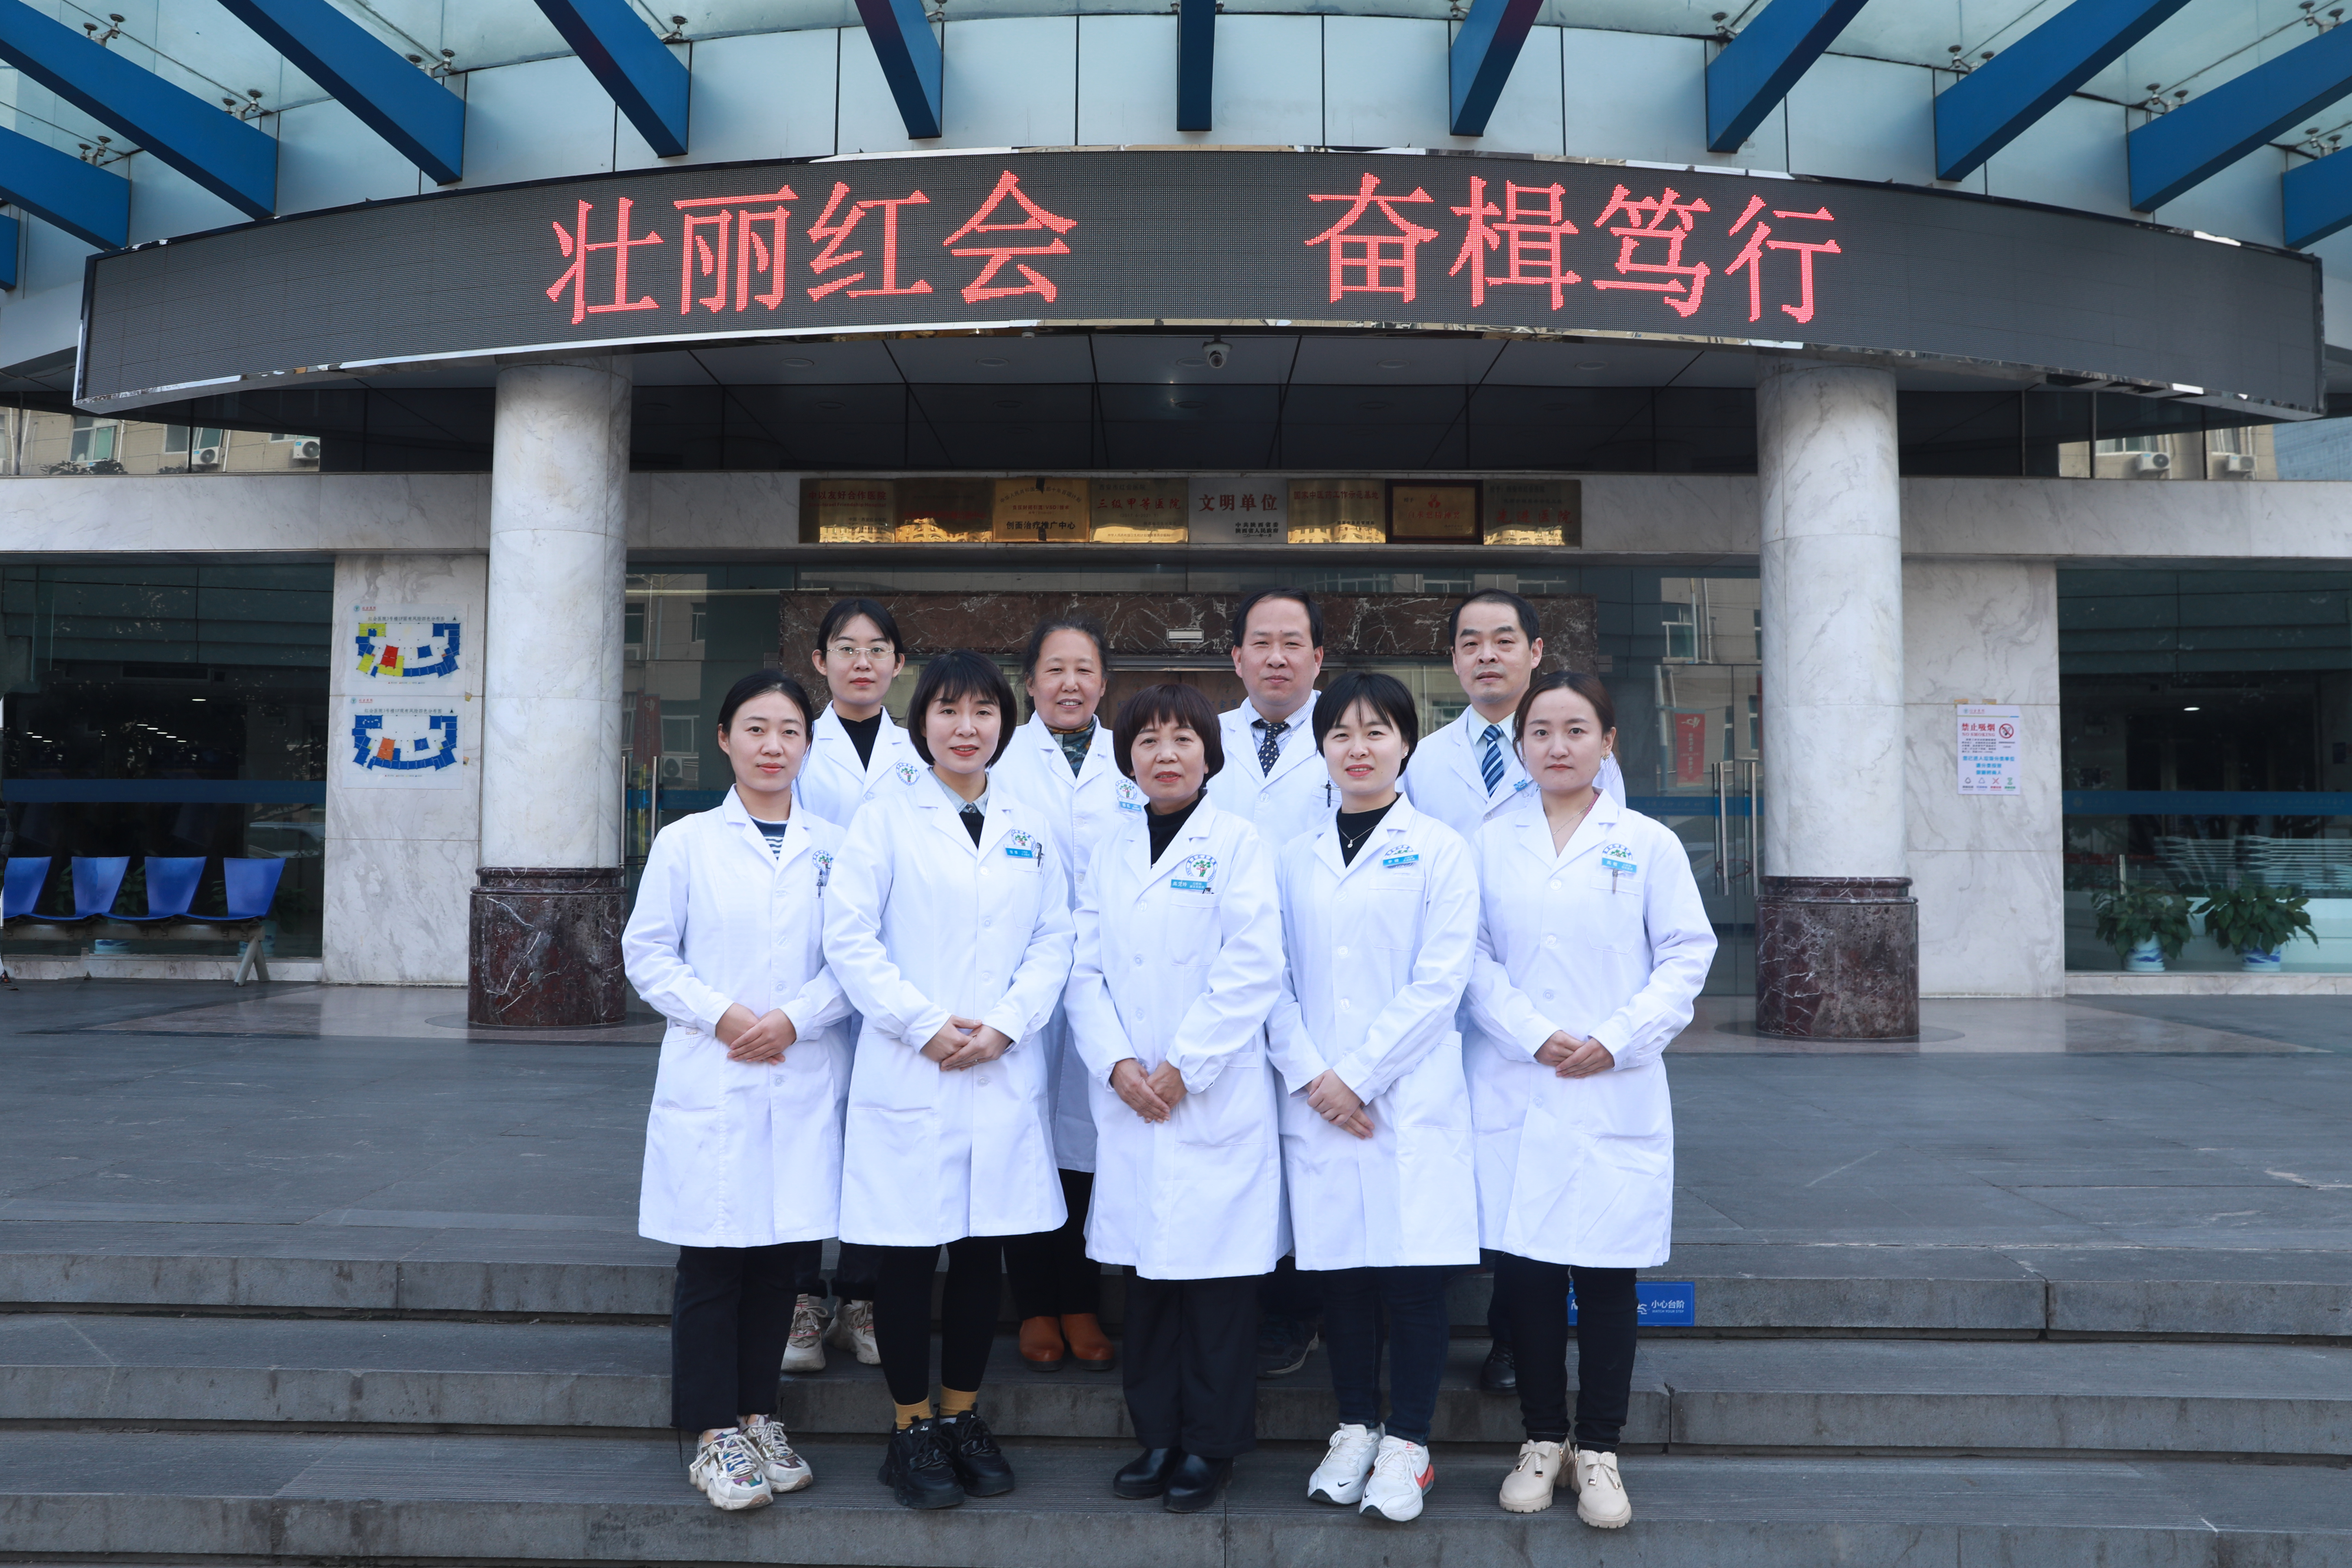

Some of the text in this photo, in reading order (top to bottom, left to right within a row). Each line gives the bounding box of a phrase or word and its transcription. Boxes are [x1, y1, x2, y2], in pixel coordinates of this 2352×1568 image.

[546, 170, 1841, 324] 壮丽红会 奋楫笃行
[809, 491, 886, 500] 中以友好合作医院
[1000, 486, 1082, 503] 中华人民共和国部十年百项计划
[1294, 491, 1379, 500] 国家中医药工作示范基地
[1097, 497, 1181, 510] 三级甲等医院
[1199, 493, 1278, 511] 文明单位
[1407, 510, 1460, 519] 白求恩精神奖
[1496, 508, 1572, 524] 先进医院
[1006, 521, 1076, 530] 创面治疗推广中心
[1651, 1300, 1685, 1309] 小心台阶
